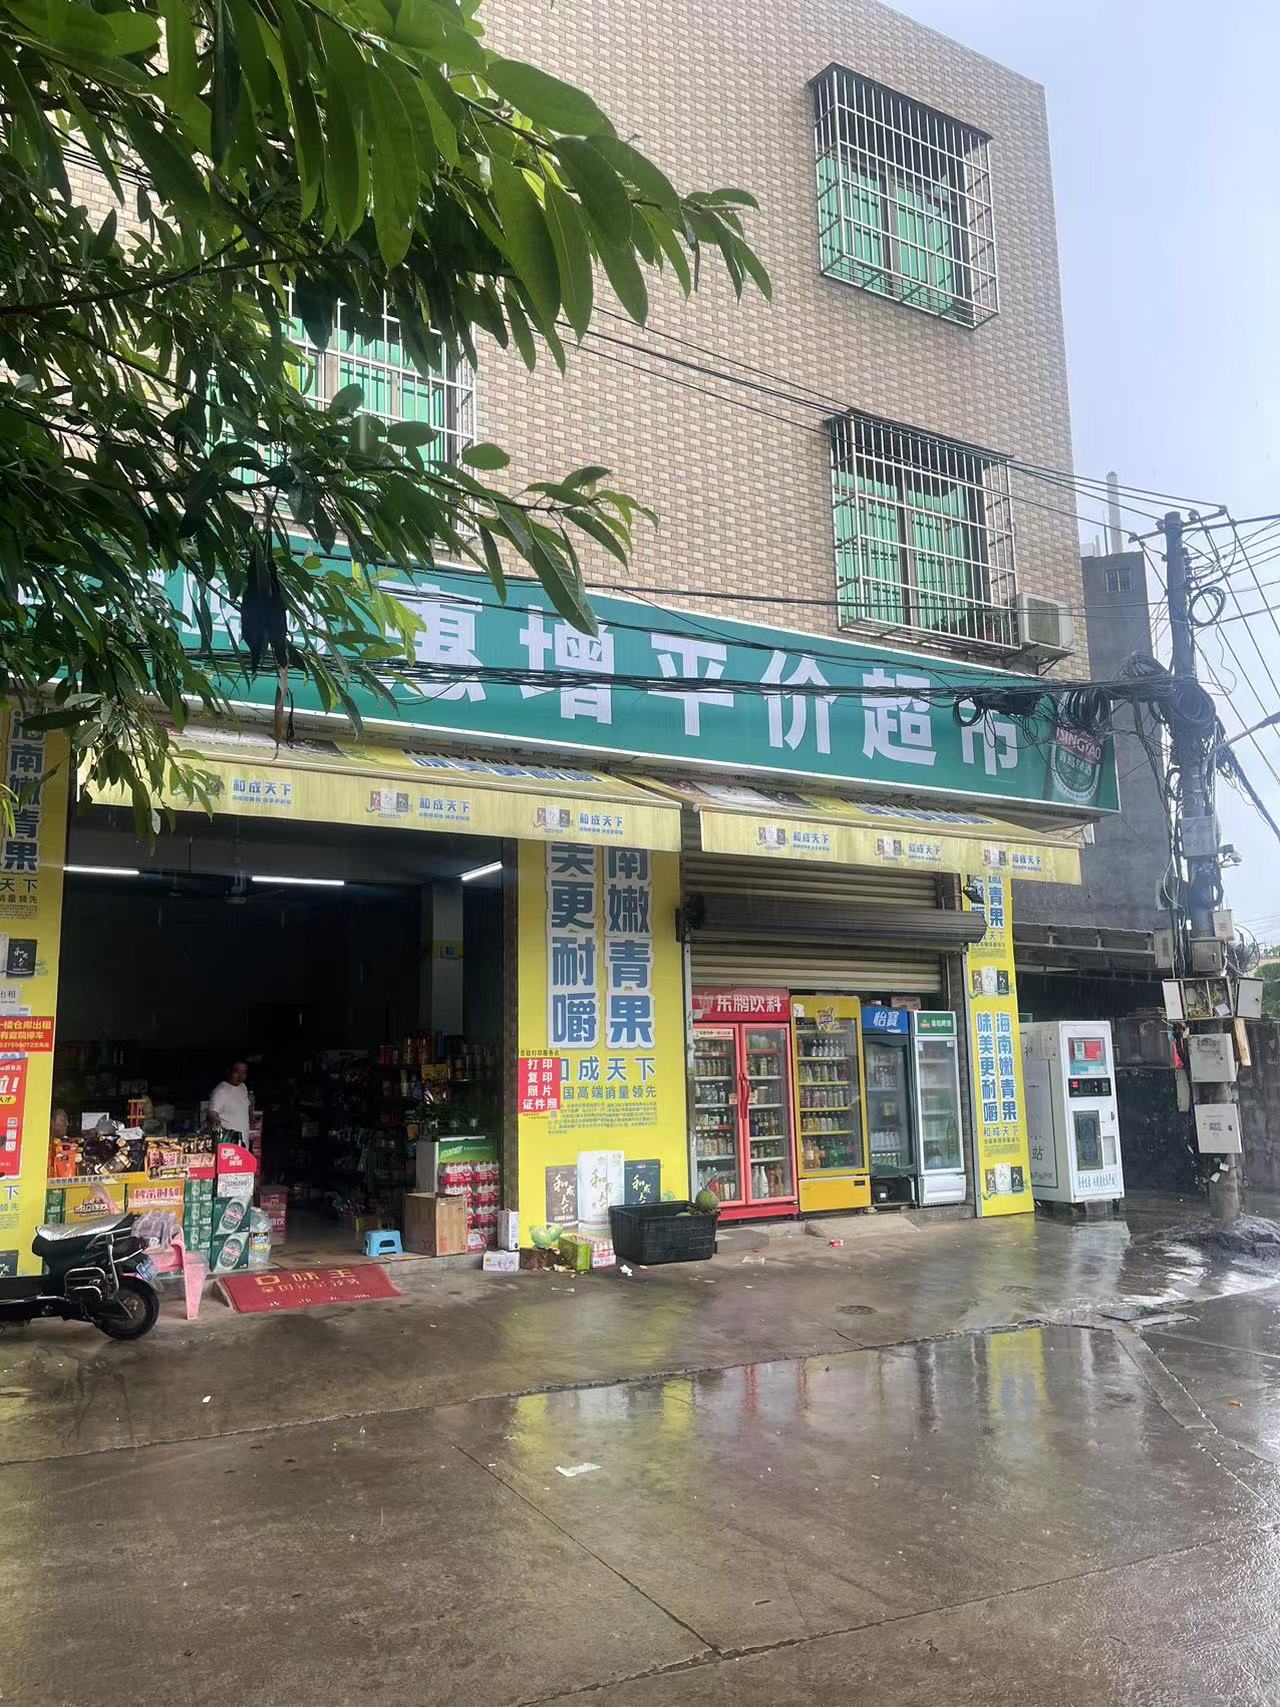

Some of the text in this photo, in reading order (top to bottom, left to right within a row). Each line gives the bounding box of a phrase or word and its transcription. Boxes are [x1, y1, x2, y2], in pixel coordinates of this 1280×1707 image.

[233, 778, 292, 796] 和成天下
[419, 797, 470, 813] 和成天下
[579, 812, 623, 828] 和成天下
[716, 994, 782, 1013] 东鹏饮料
[873, 1011, 900, 1027] 怡寶
[527, 1058, 553, 1070] 打印
[977, 1013, 999, 1123] 味美更耐嚼
[996, 1012, 1017, 1122] 海南嫩青果
[527, 1072, 553, 1084] 复印
[527, 1086, 553, 1097] 照片
[523, 1099, 558, 1110] 证件照
